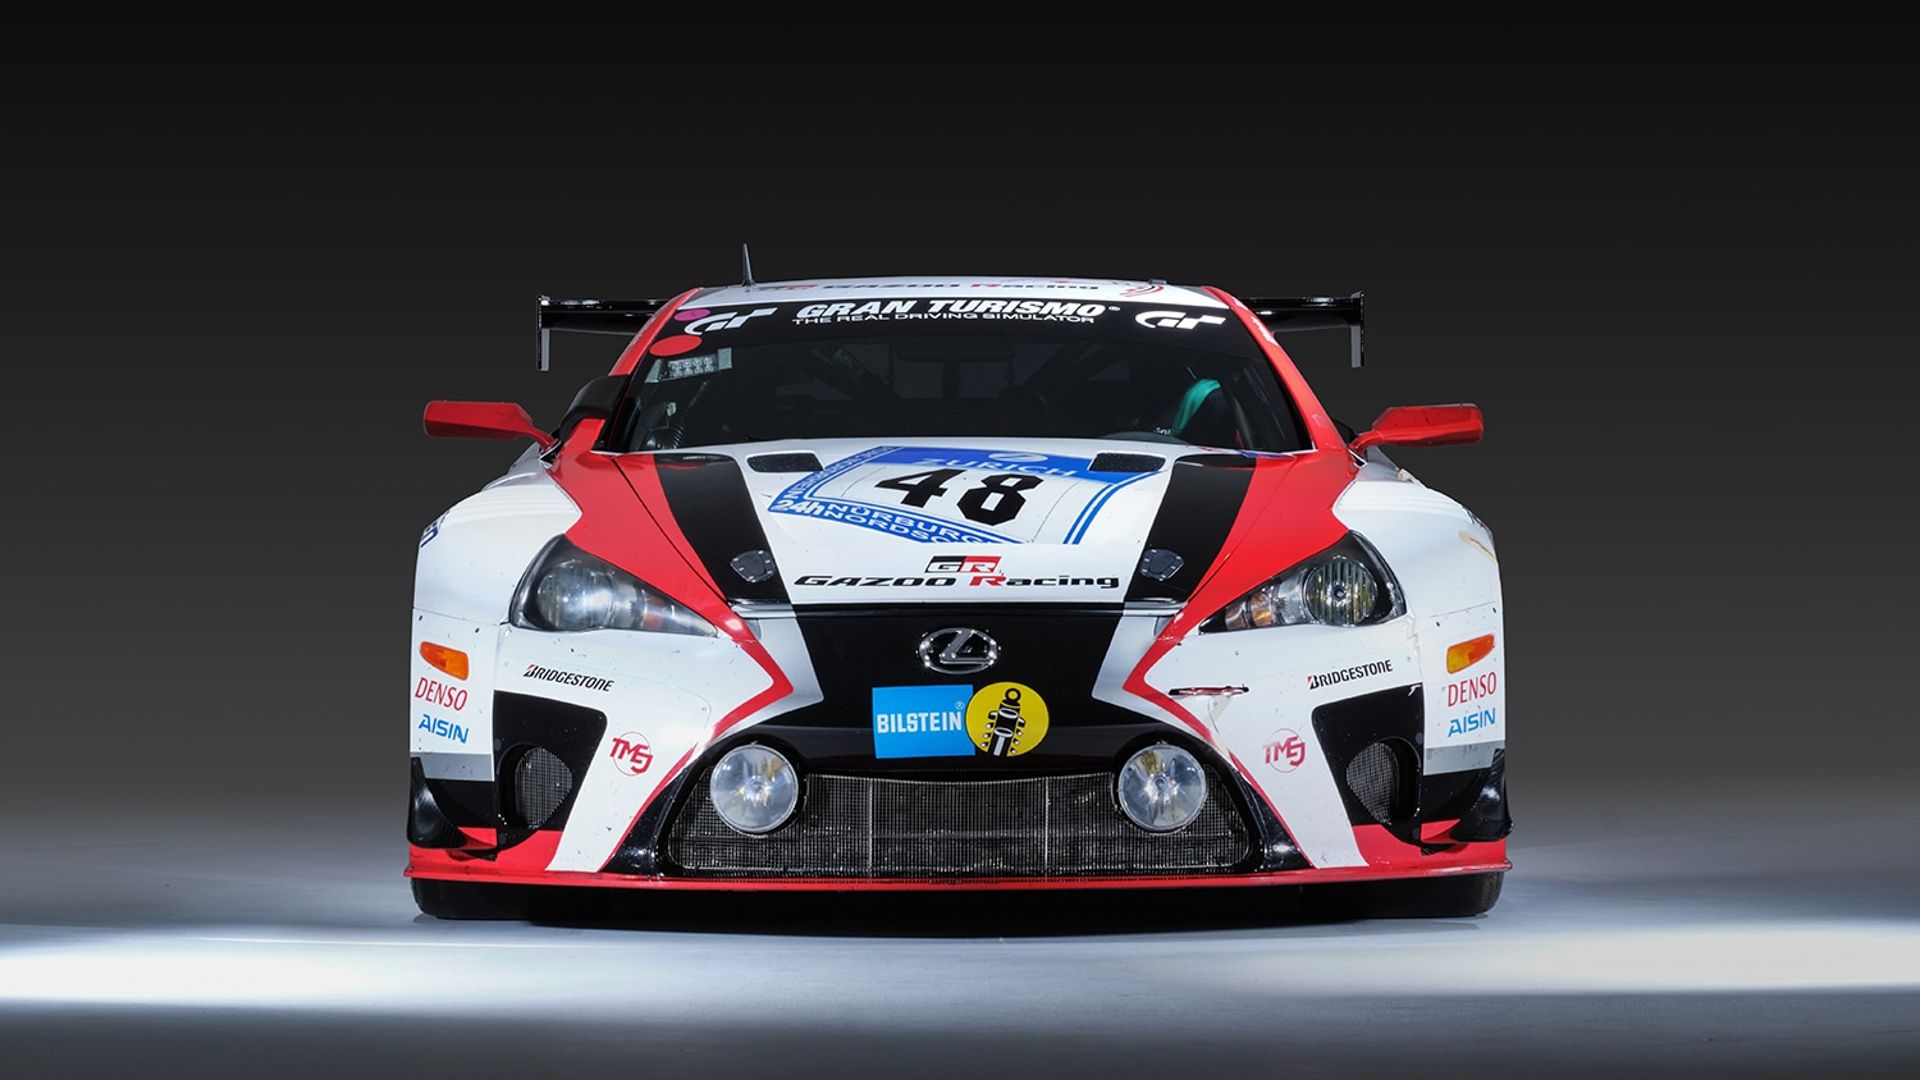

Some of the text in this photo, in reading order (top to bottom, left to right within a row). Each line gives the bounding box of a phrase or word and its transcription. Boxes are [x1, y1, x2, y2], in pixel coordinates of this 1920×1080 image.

[792, 312, 1095, 325] THE REAL DRIVING SIMULATOR
[796, 300, 1106, 319] GRAN TURISMO
[771, 499, 825, 516] 24h
[875, 468, 1044, 527] 48
[924, 555, 1002, 574] GR
[794, 575, 1120, 589] GAZOO Racing
[522, 664, 615, 692] BRIDGESTONE
[1307, 659, 1394, 690] BRIDGESTONE
[414, 677, 468, 711] DENSO
[1447, 671, 1497, 707] DENSO
[418, 713, 469, 743] AISIN
[876, 711, 963, 734] BILSTEIN
[1447, 707, 1496, 737] AISIN
